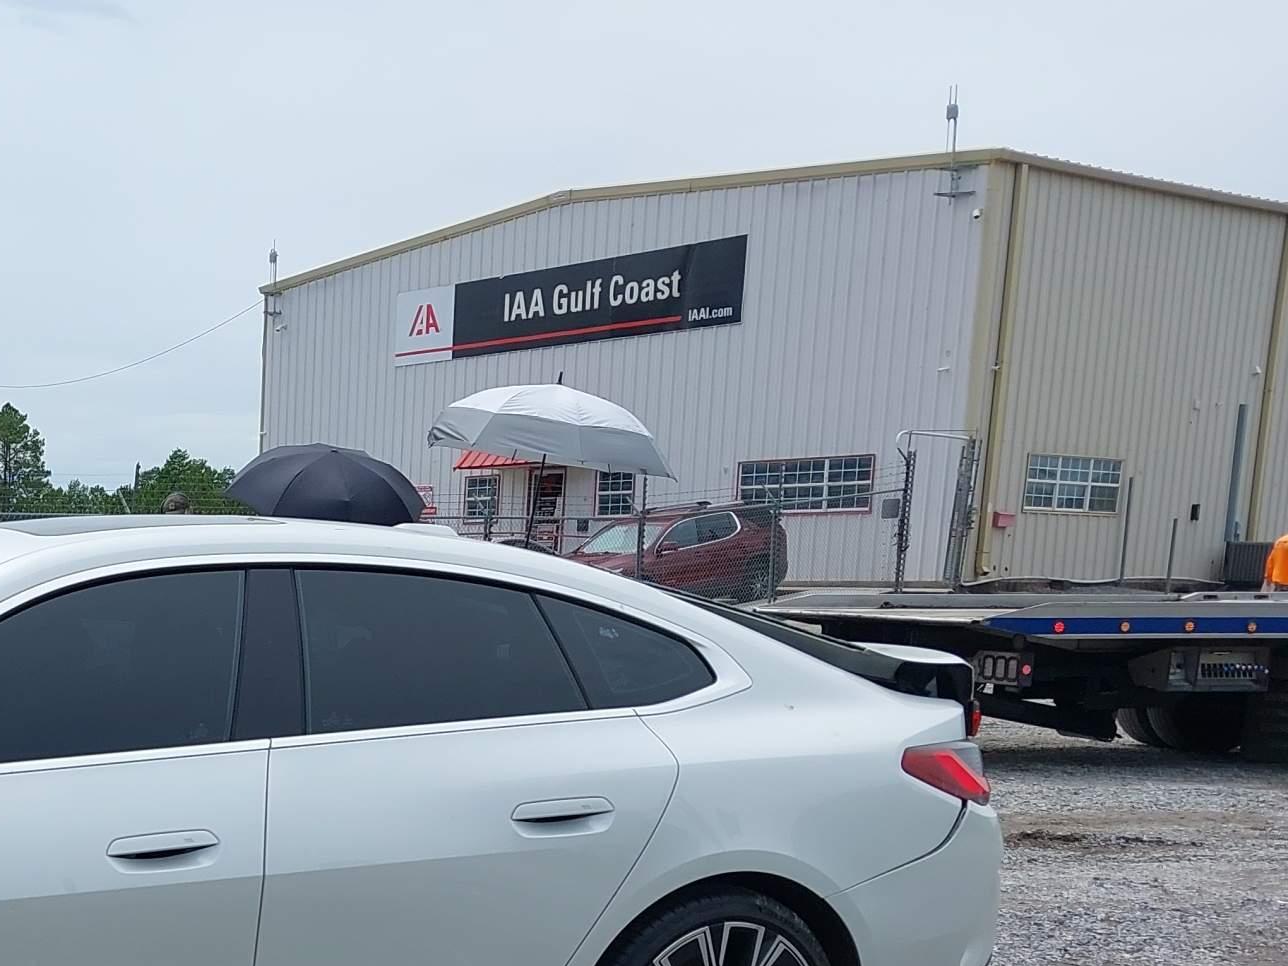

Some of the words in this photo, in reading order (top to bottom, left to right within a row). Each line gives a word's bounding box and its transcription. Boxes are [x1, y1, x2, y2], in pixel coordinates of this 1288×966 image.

[503, 288, 545, 322] IAA
[552, 278, 603, 315] Gulf
[609, 269, 682, 307] Coast
[687, 306, 733, 322] IAAI.com
